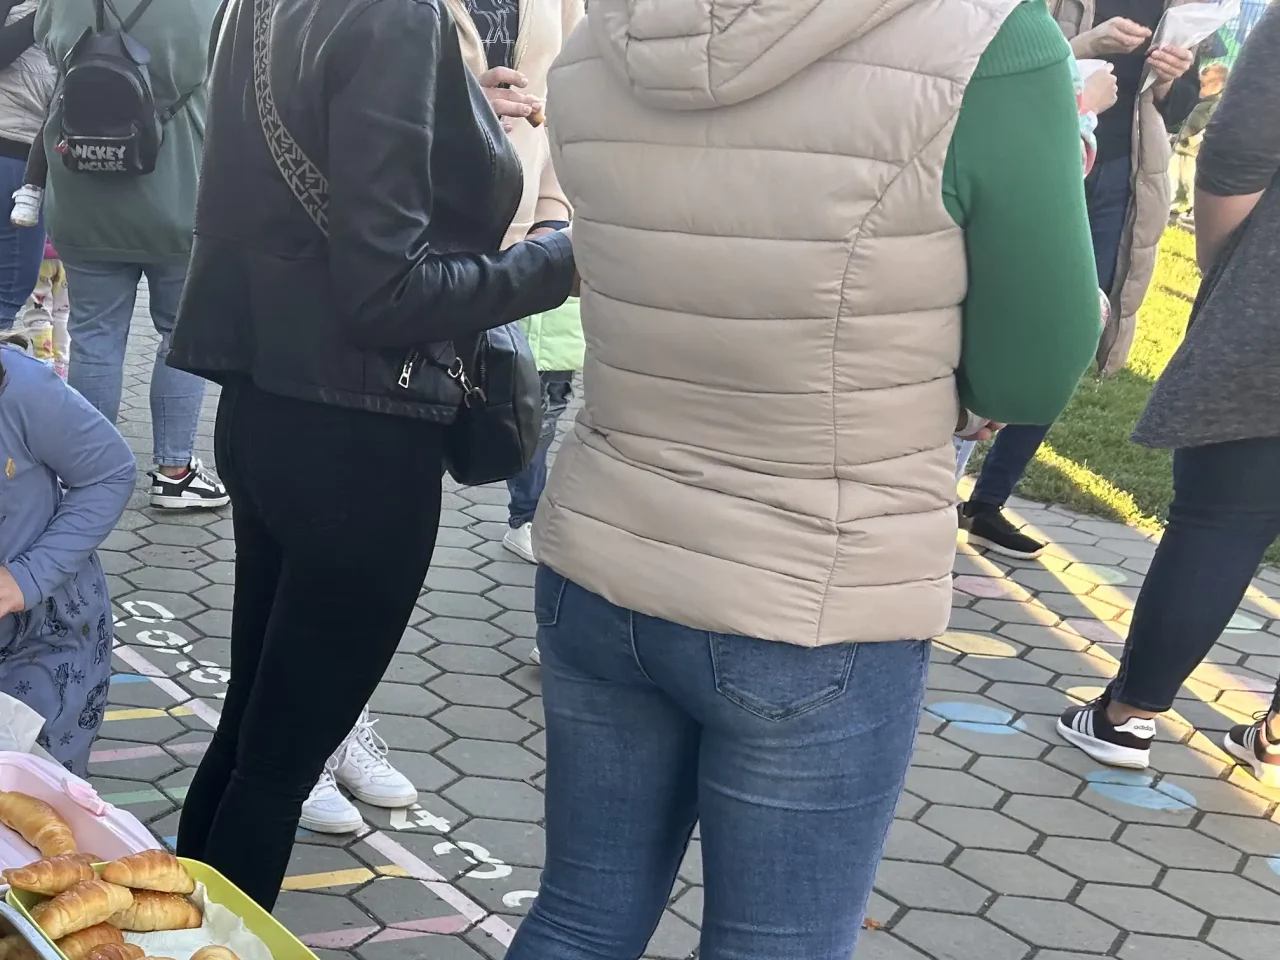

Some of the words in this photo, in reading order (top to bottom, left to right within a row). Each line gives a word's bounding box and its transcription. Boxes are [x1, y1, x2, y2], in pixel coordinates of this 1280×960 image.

[70, 144, 126, 160] MICKEY
[78, 160, 127, 171] MOUSE
[113, 601, 175, 626] 0
[432, 841, 513, 880] 3
